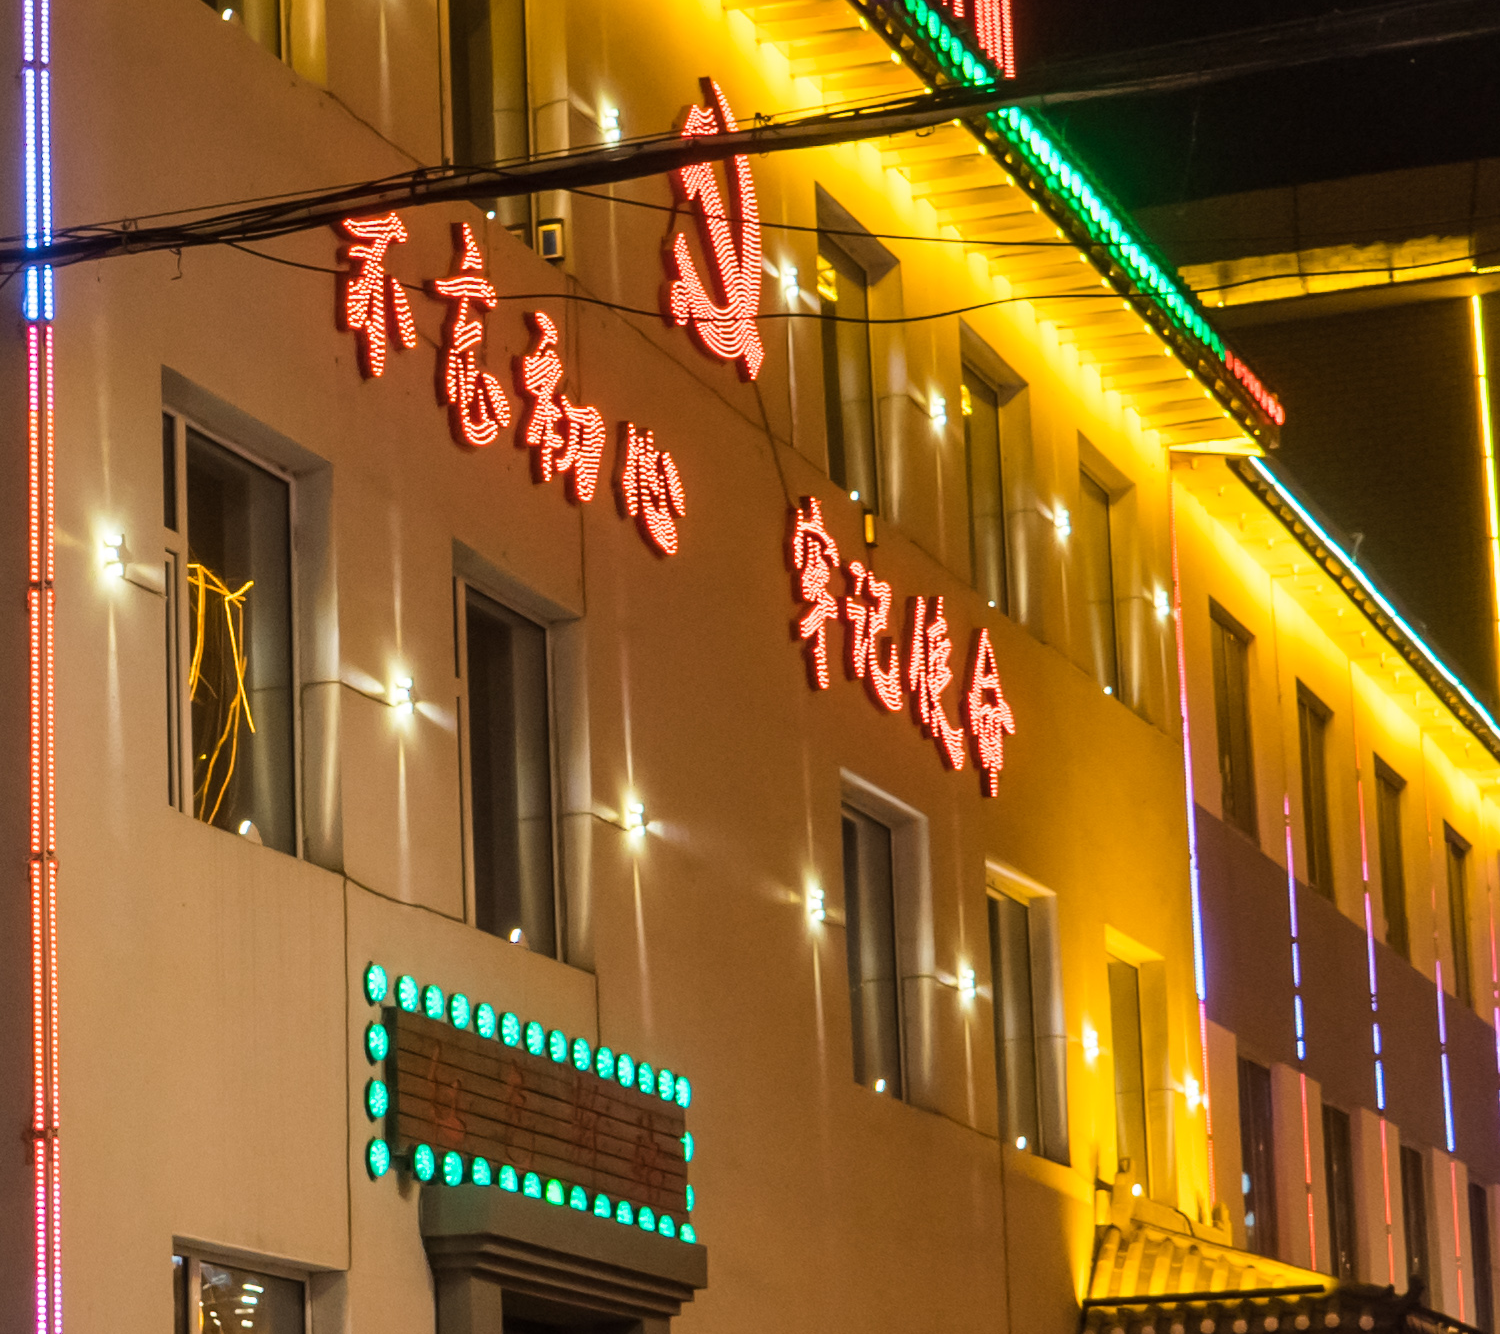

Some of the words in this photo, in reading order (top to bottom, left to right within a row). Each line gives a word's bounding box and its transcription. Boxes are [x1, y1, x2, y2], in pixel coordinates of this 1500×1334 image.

[340, 212, 686, 555] 不忘初心
[794, 495, 1016, 799] 牢记使命
